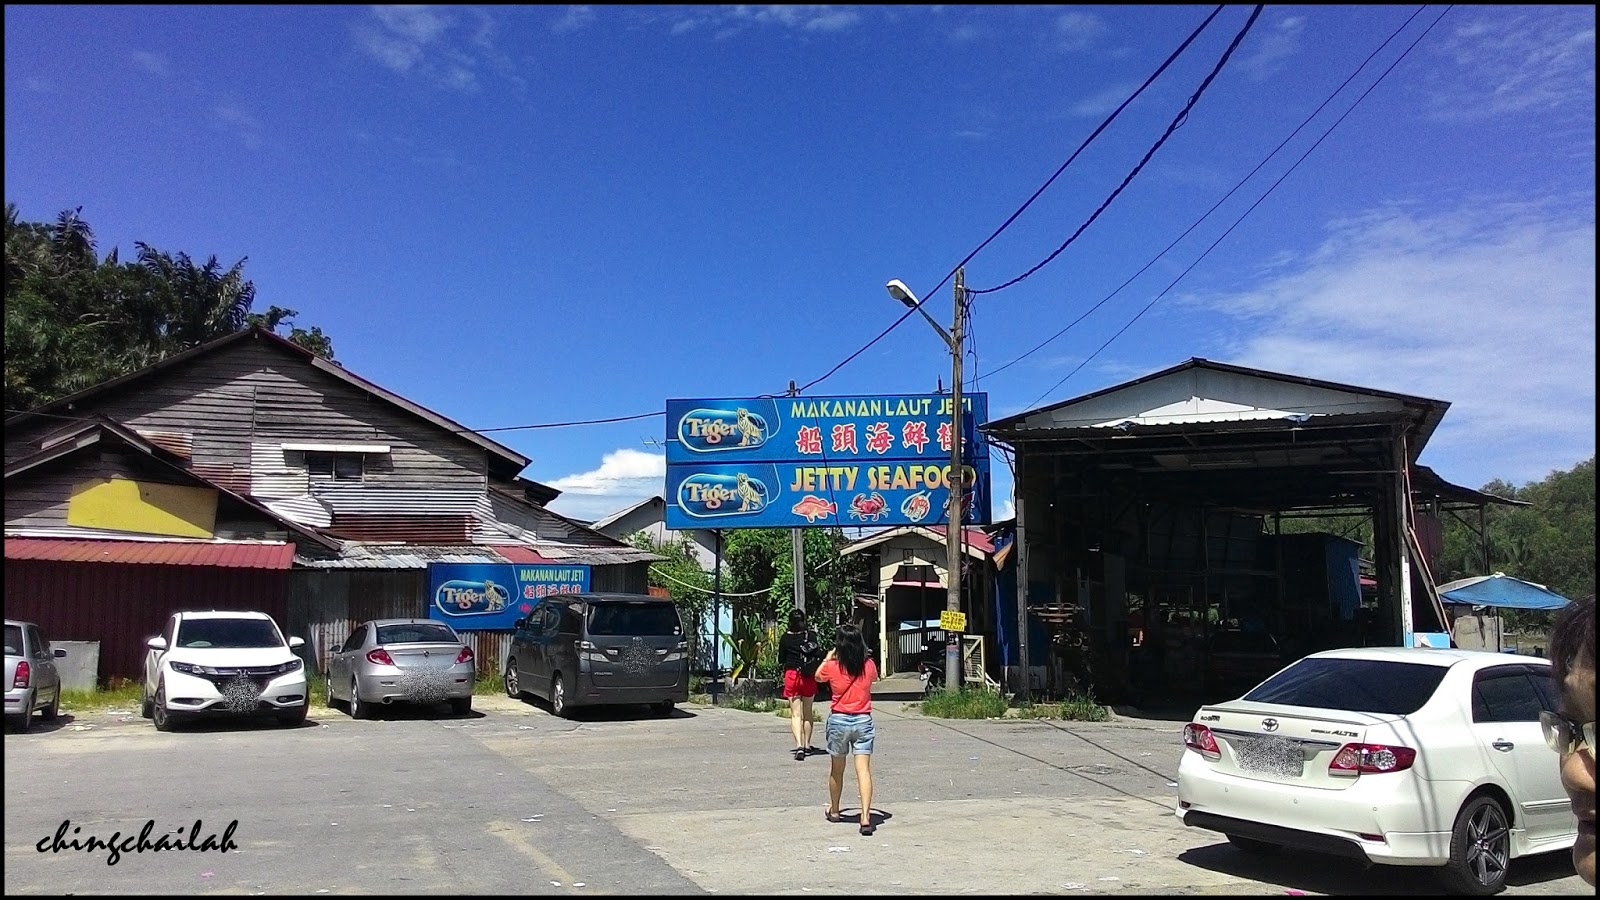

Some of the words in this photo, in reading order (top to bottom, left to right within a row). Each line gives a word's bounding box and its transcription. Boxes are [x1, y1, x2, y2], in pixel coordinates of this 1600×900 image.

[791, 400, 881, 418] MAKANAN
[885, 398, 932, 416] LAUT
[686, 418, 738, 444] Tiger
[790, 466, 859, 491] JETTY
[686, 483, 738, 509] Tiger
[520, 569, 554, 582] MAKANAN
[554, 569, 571, 582] LAUT
[571, 569, 584, 582] JETI
[443, 588, 486, 610] Tiger
